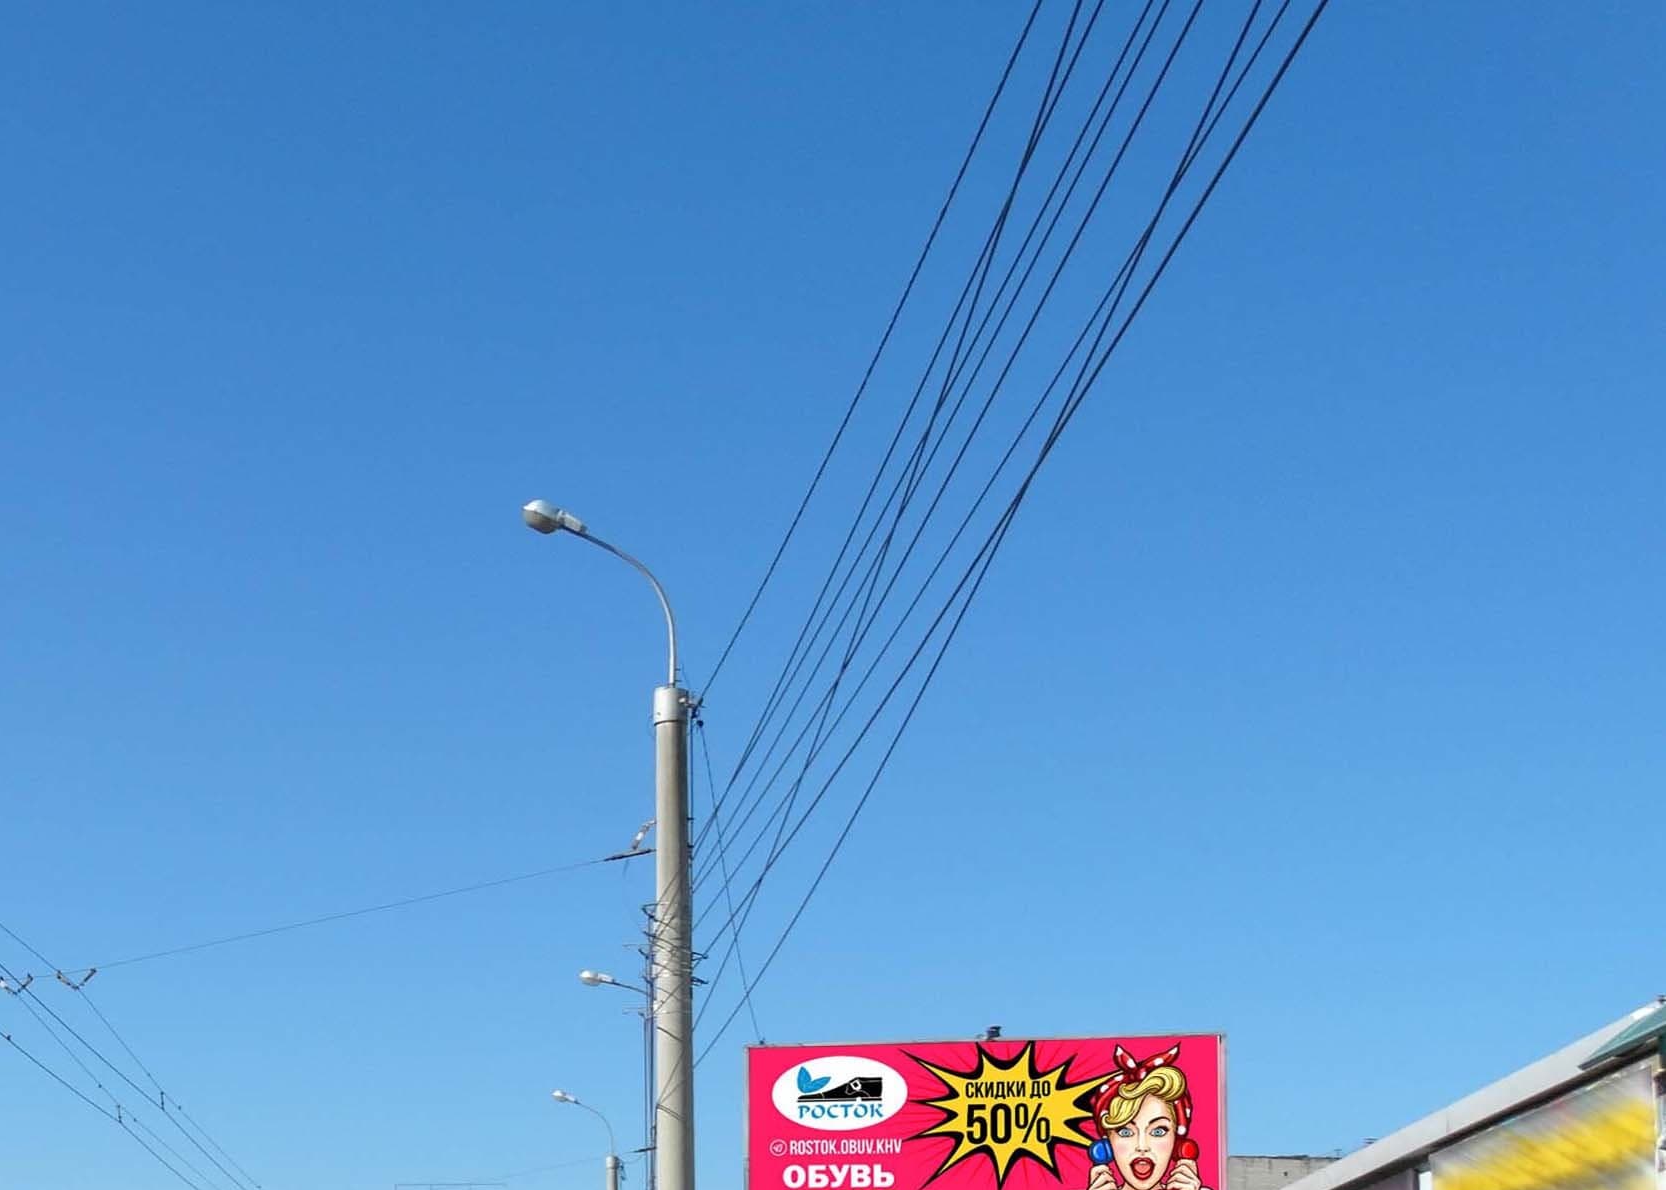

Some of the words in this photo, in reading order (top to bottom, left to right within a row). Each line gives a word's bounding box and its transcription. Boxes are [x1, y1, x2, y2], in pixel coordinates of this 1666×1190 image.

[965, 1081, 1026, 1100] СКИДКИ
[1029, 1080, 1051, 1099] ДО
[797, 1103, 884, 1119] РОСТОК
[966, 1102, 1051, 1145] 50%
[789, 1138, 902, 1155] ROSTOK.OBUV.KHV
[782, 1163, 895, 1189] ОБУВЬ
